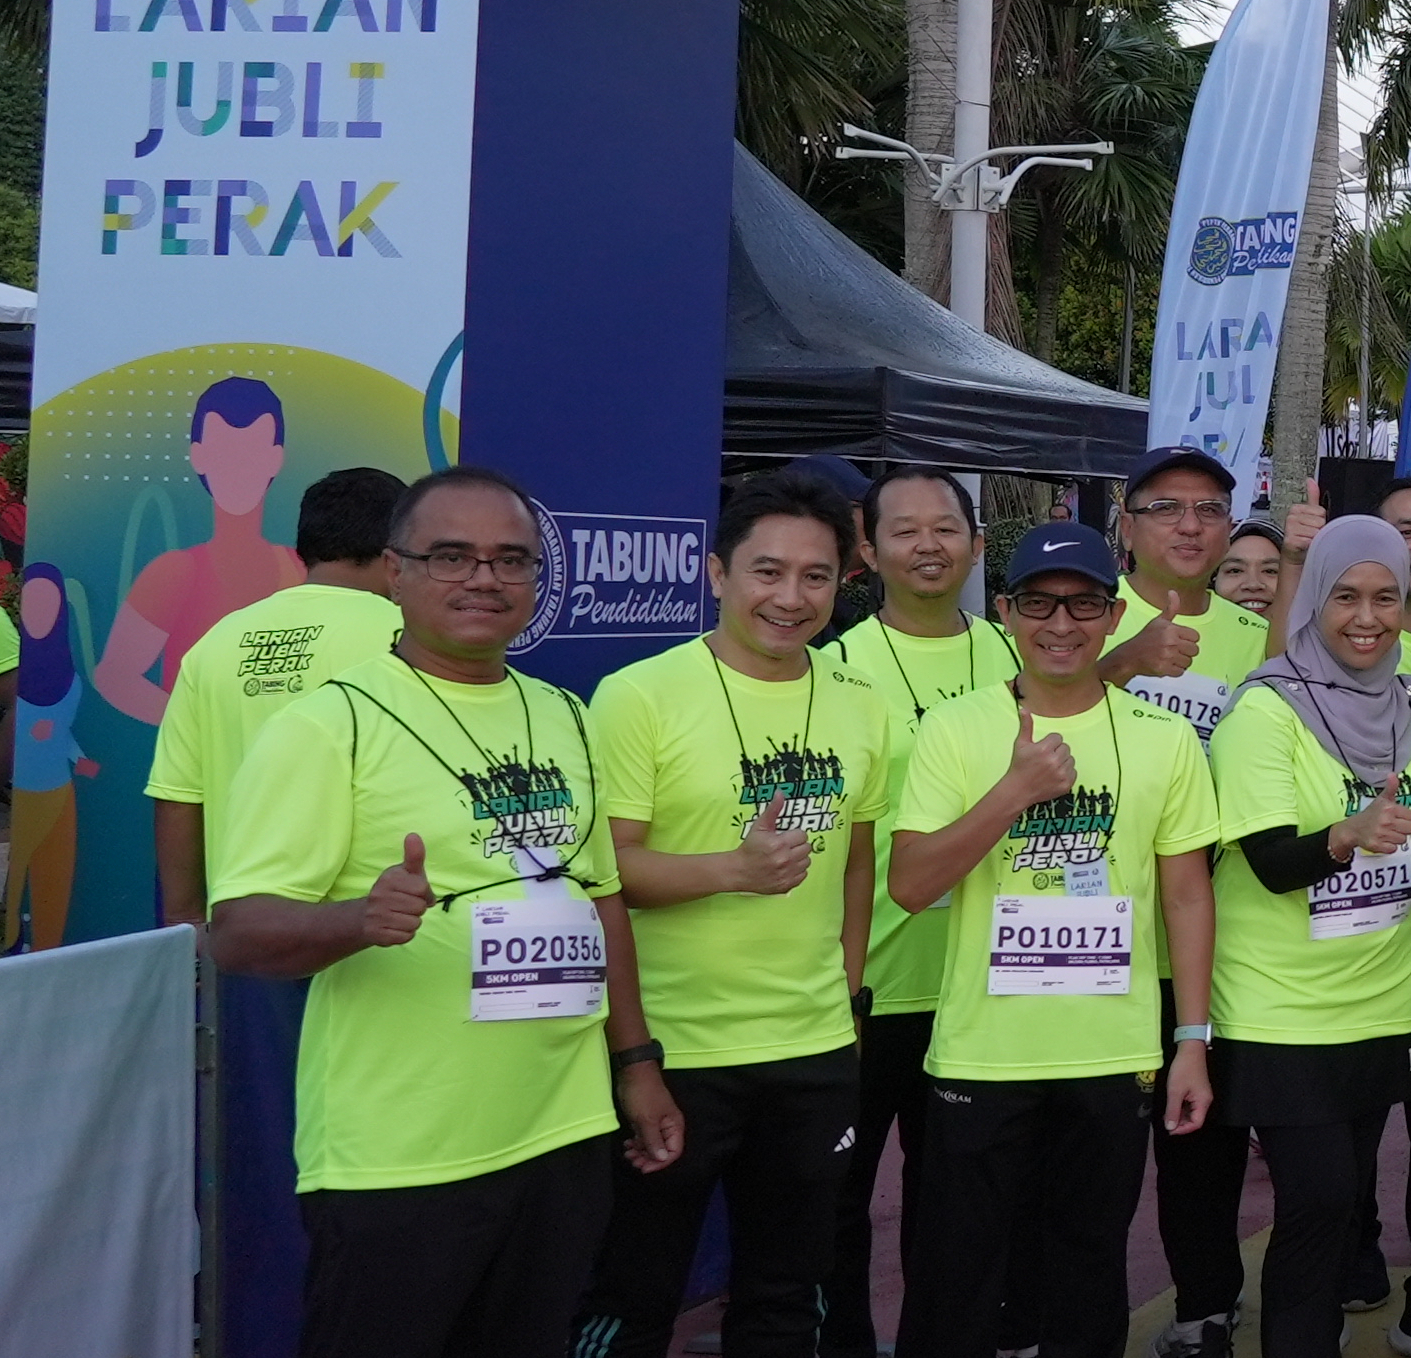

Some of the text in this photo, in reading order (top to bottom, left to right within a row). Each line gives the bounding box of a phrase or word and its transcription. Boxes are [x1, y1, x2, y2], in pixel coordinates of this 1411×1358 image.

[135, 62, 385, 158] JUBLI
[101, 179, 403, 258] PERAK
[571, 529, 699, 584] TABUNG
[569, 584, 698, 629] Pendidikan
[239, 624, 325, 648] LARIAN
[1250, 621, 1268, 630] spi
[247, 641, 309, 661] JUBLI
[237, 653, 314, 678] PERAK
[846, 677, 872, 690] spin
[472, 788, 574, 821] LARIAN
[491, 806, 566, 838] JUBLI
[1008, 814, 1114, 839] LARIAN
[1021, 831, 1100, 854] JUBLI
[511, 971, 539, 983] OPEN
